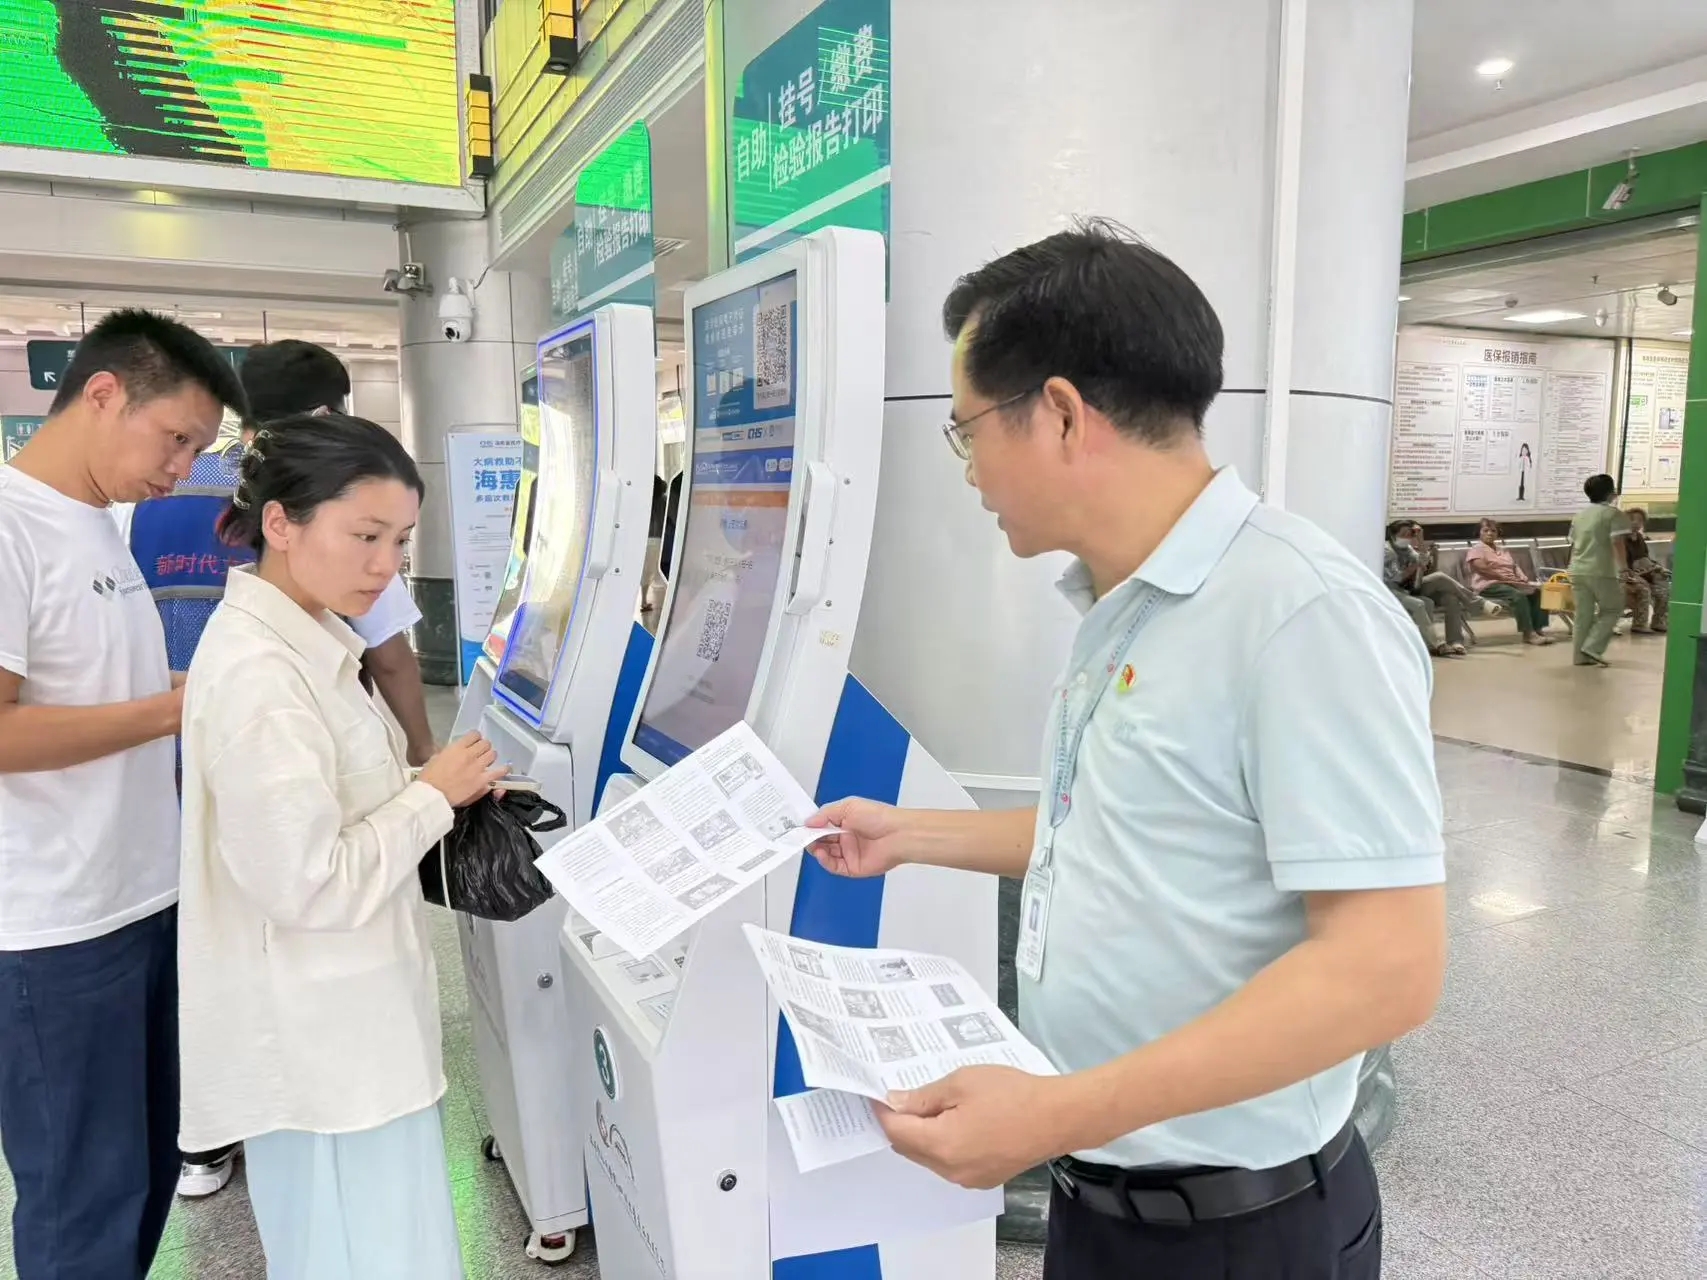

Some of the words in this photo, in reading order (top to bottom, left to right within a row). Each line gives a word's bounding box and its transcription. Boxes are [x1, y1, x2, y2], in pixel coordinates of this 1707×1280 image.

[778, 66, 815, 133] 挂号
[737, 122, 768, 182] 自助
[773, 83, 883, 189] 检验报告打印
[1484, 348, 1538, 365] 医保报销指南
